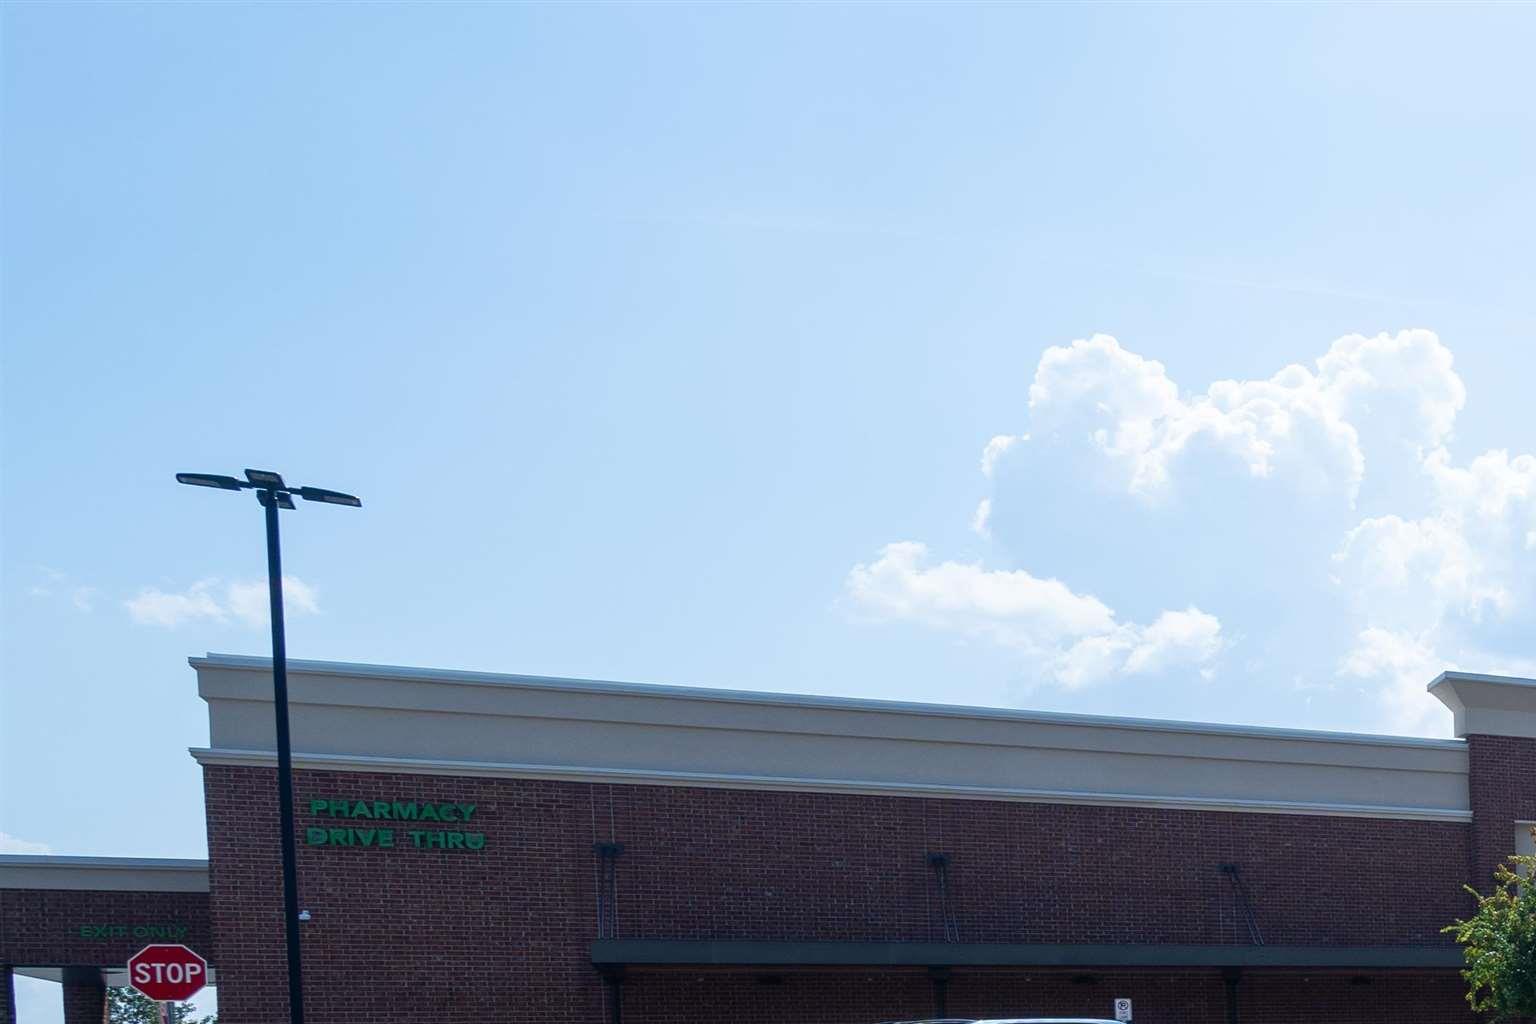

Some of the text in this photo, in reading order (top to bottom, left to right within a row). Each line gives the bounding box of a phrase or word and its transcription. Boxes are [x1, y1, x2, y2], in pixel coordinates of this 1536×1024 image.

[311, 800, 476, 821] PHARMACY
[307, 828, 486, 849] DRIVE THRU
[80, 927, 188, 938] EXIT ONLY
[134, 963, 202, 984] STOP
